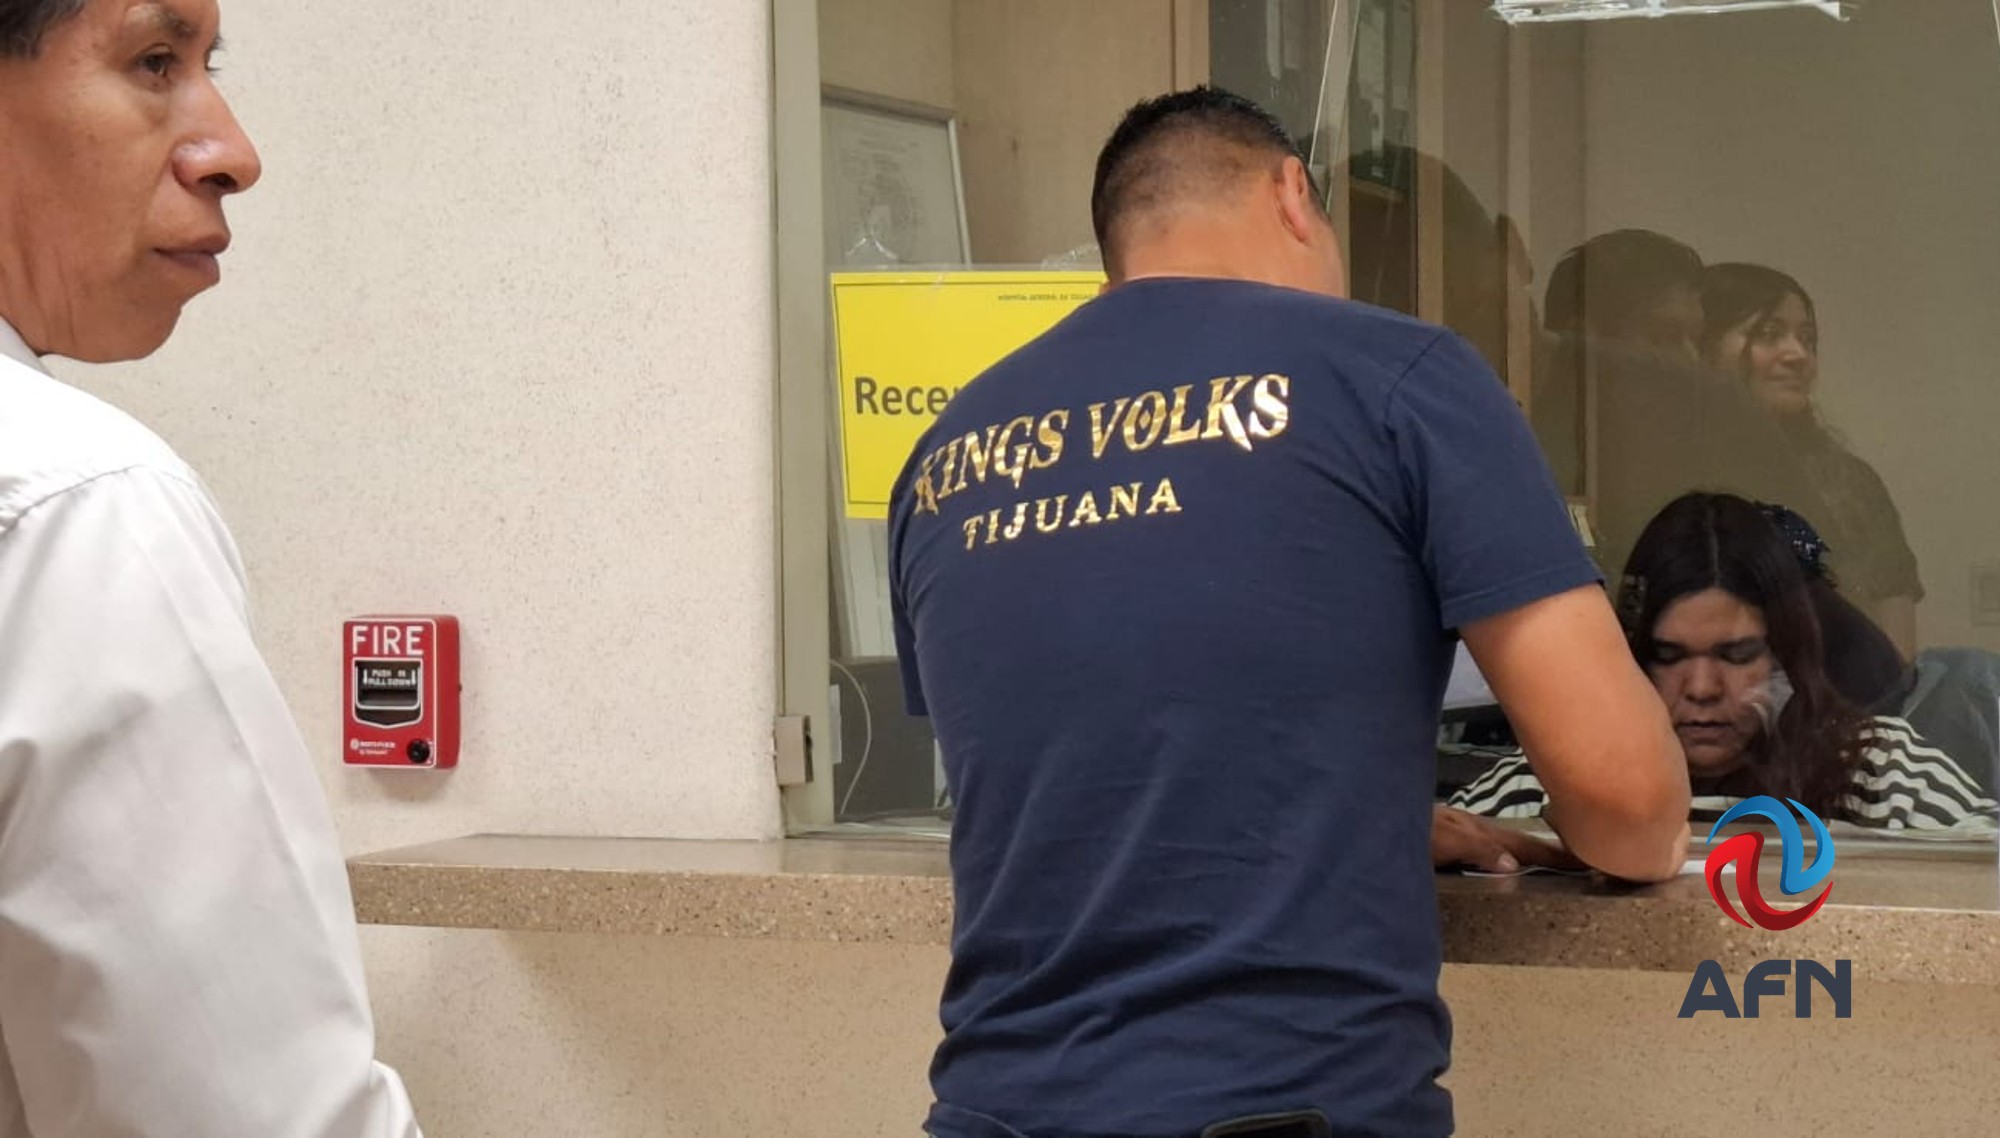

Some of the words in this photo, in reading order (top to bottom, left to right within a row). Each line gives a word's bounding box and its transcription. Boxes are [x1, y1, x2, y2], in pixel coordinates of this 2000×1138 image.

[854, 377, 959, 415] Rece
[912, 407, 1070, 517] KINGS
[1087, 372, 1291, 459] VOLKS
[962, 477, 1183, 551] TIJUANA
[352, 625, 424, 655] FIRE
